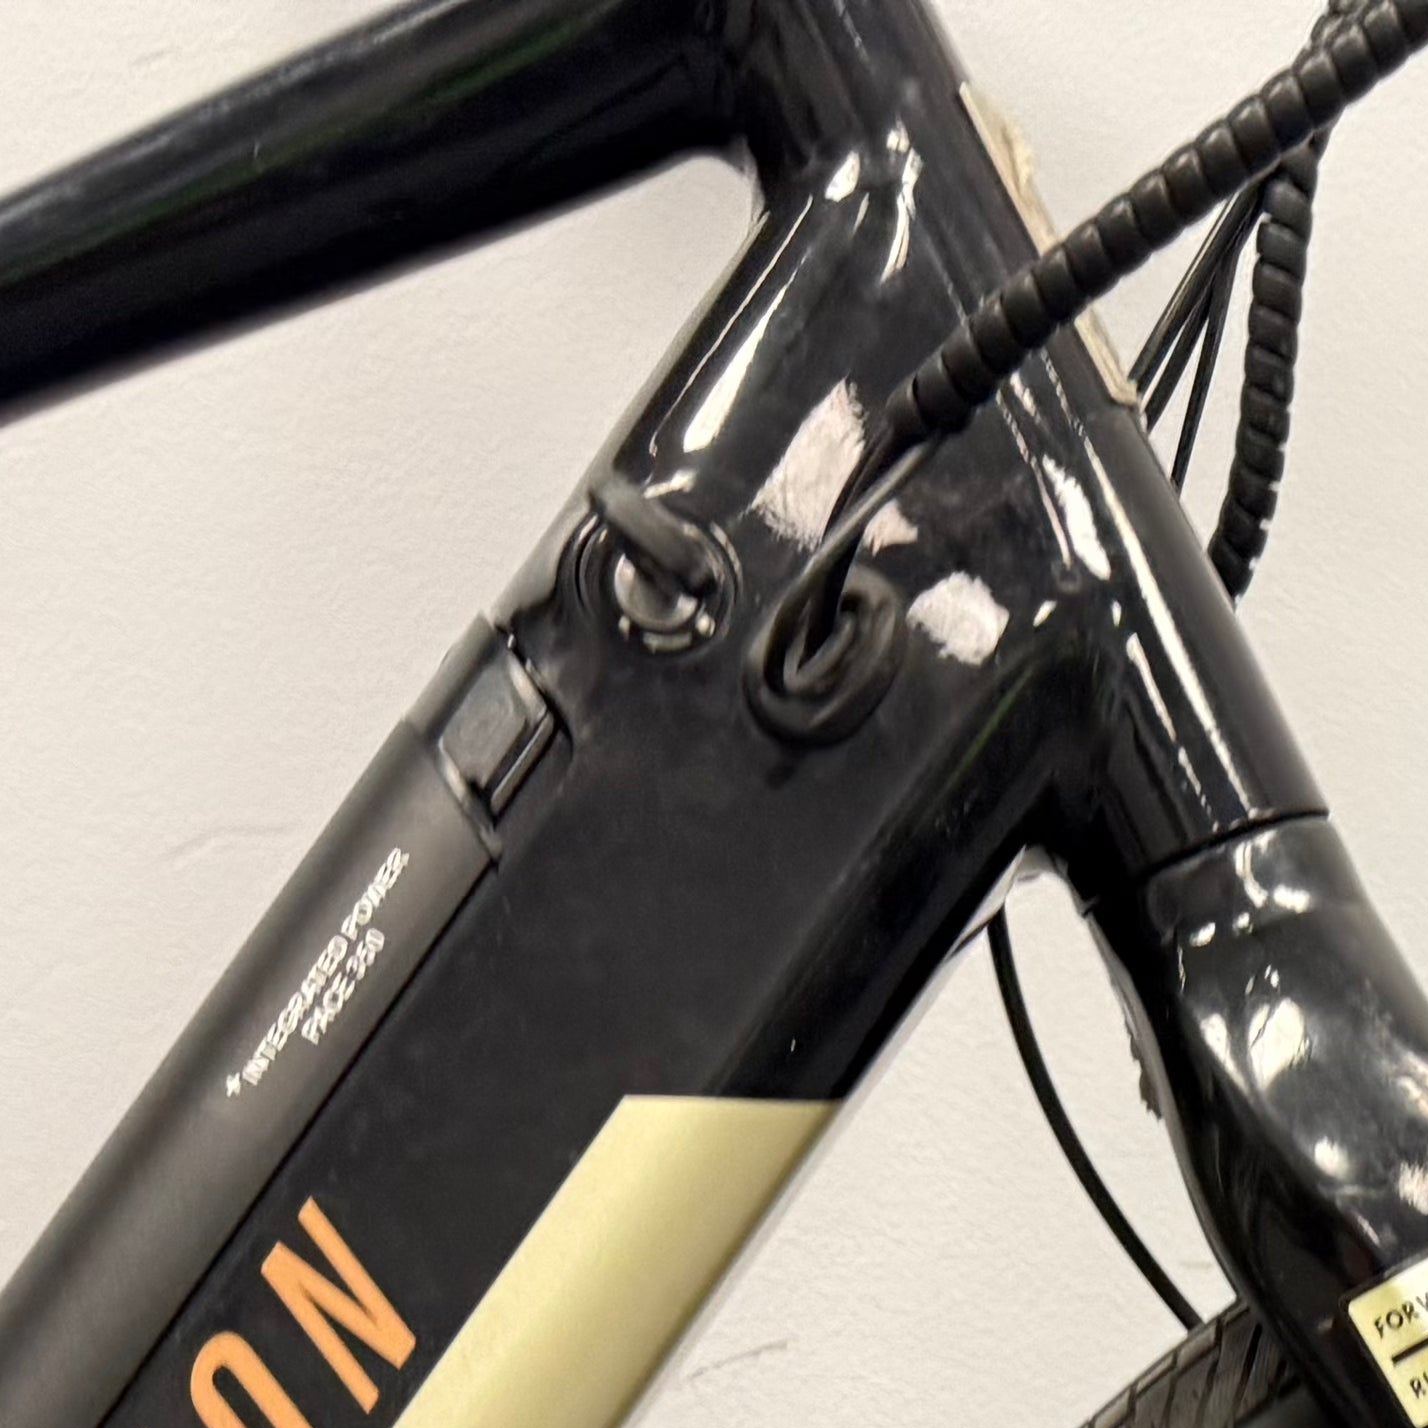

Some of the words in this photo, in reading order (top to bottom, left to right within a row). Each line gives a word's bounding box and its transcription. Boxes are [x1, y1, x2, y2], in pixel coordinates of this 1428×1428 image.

[242, 934, 348, 1085] INTEGRATED
[341, 848, 410, 940] POWER
[302, 972, 356, 1045] PACE
[346, 927, 385, 981] 350
